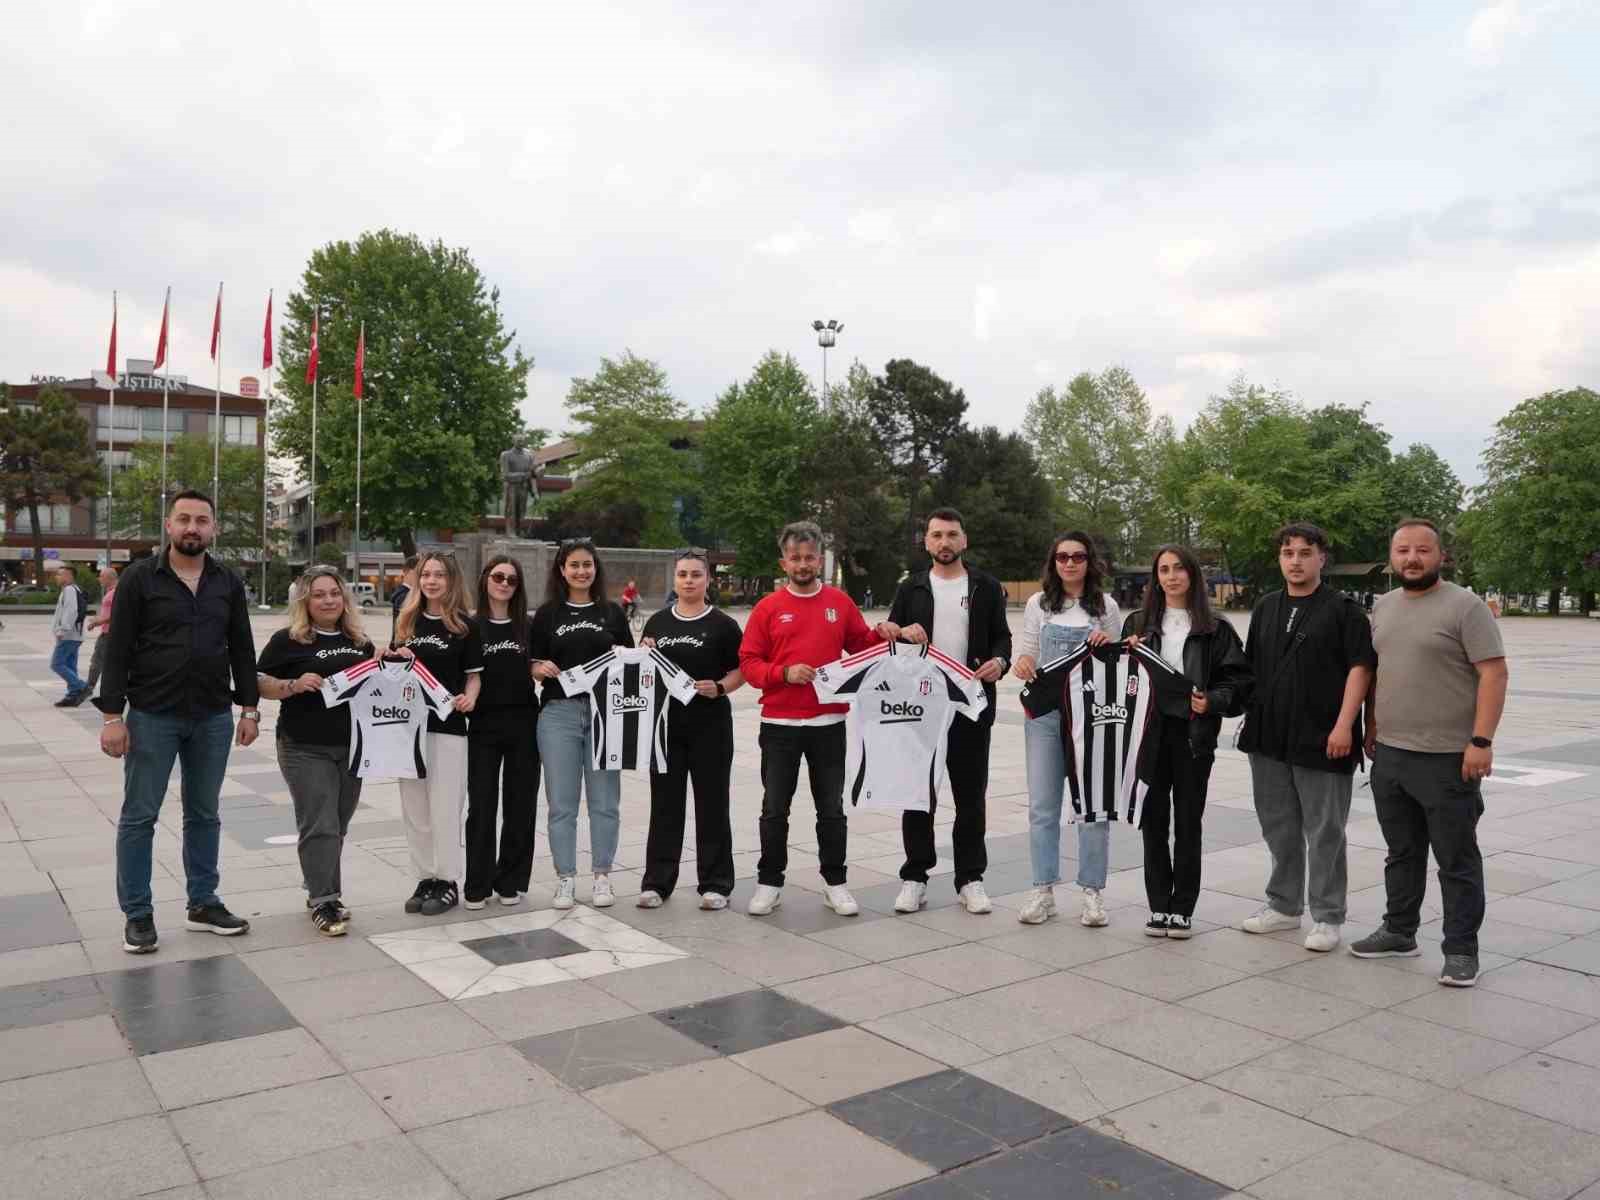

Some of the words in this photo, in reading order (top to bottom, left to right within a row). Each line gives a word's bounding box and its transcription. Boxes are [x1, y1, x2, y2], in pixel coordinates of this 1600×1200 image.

[613, 694, 648, 707] beko
[372, 705, 410, 719] beko
[881, 700, 924, 716] beko
[1092, 703, 1128, 718] beko
